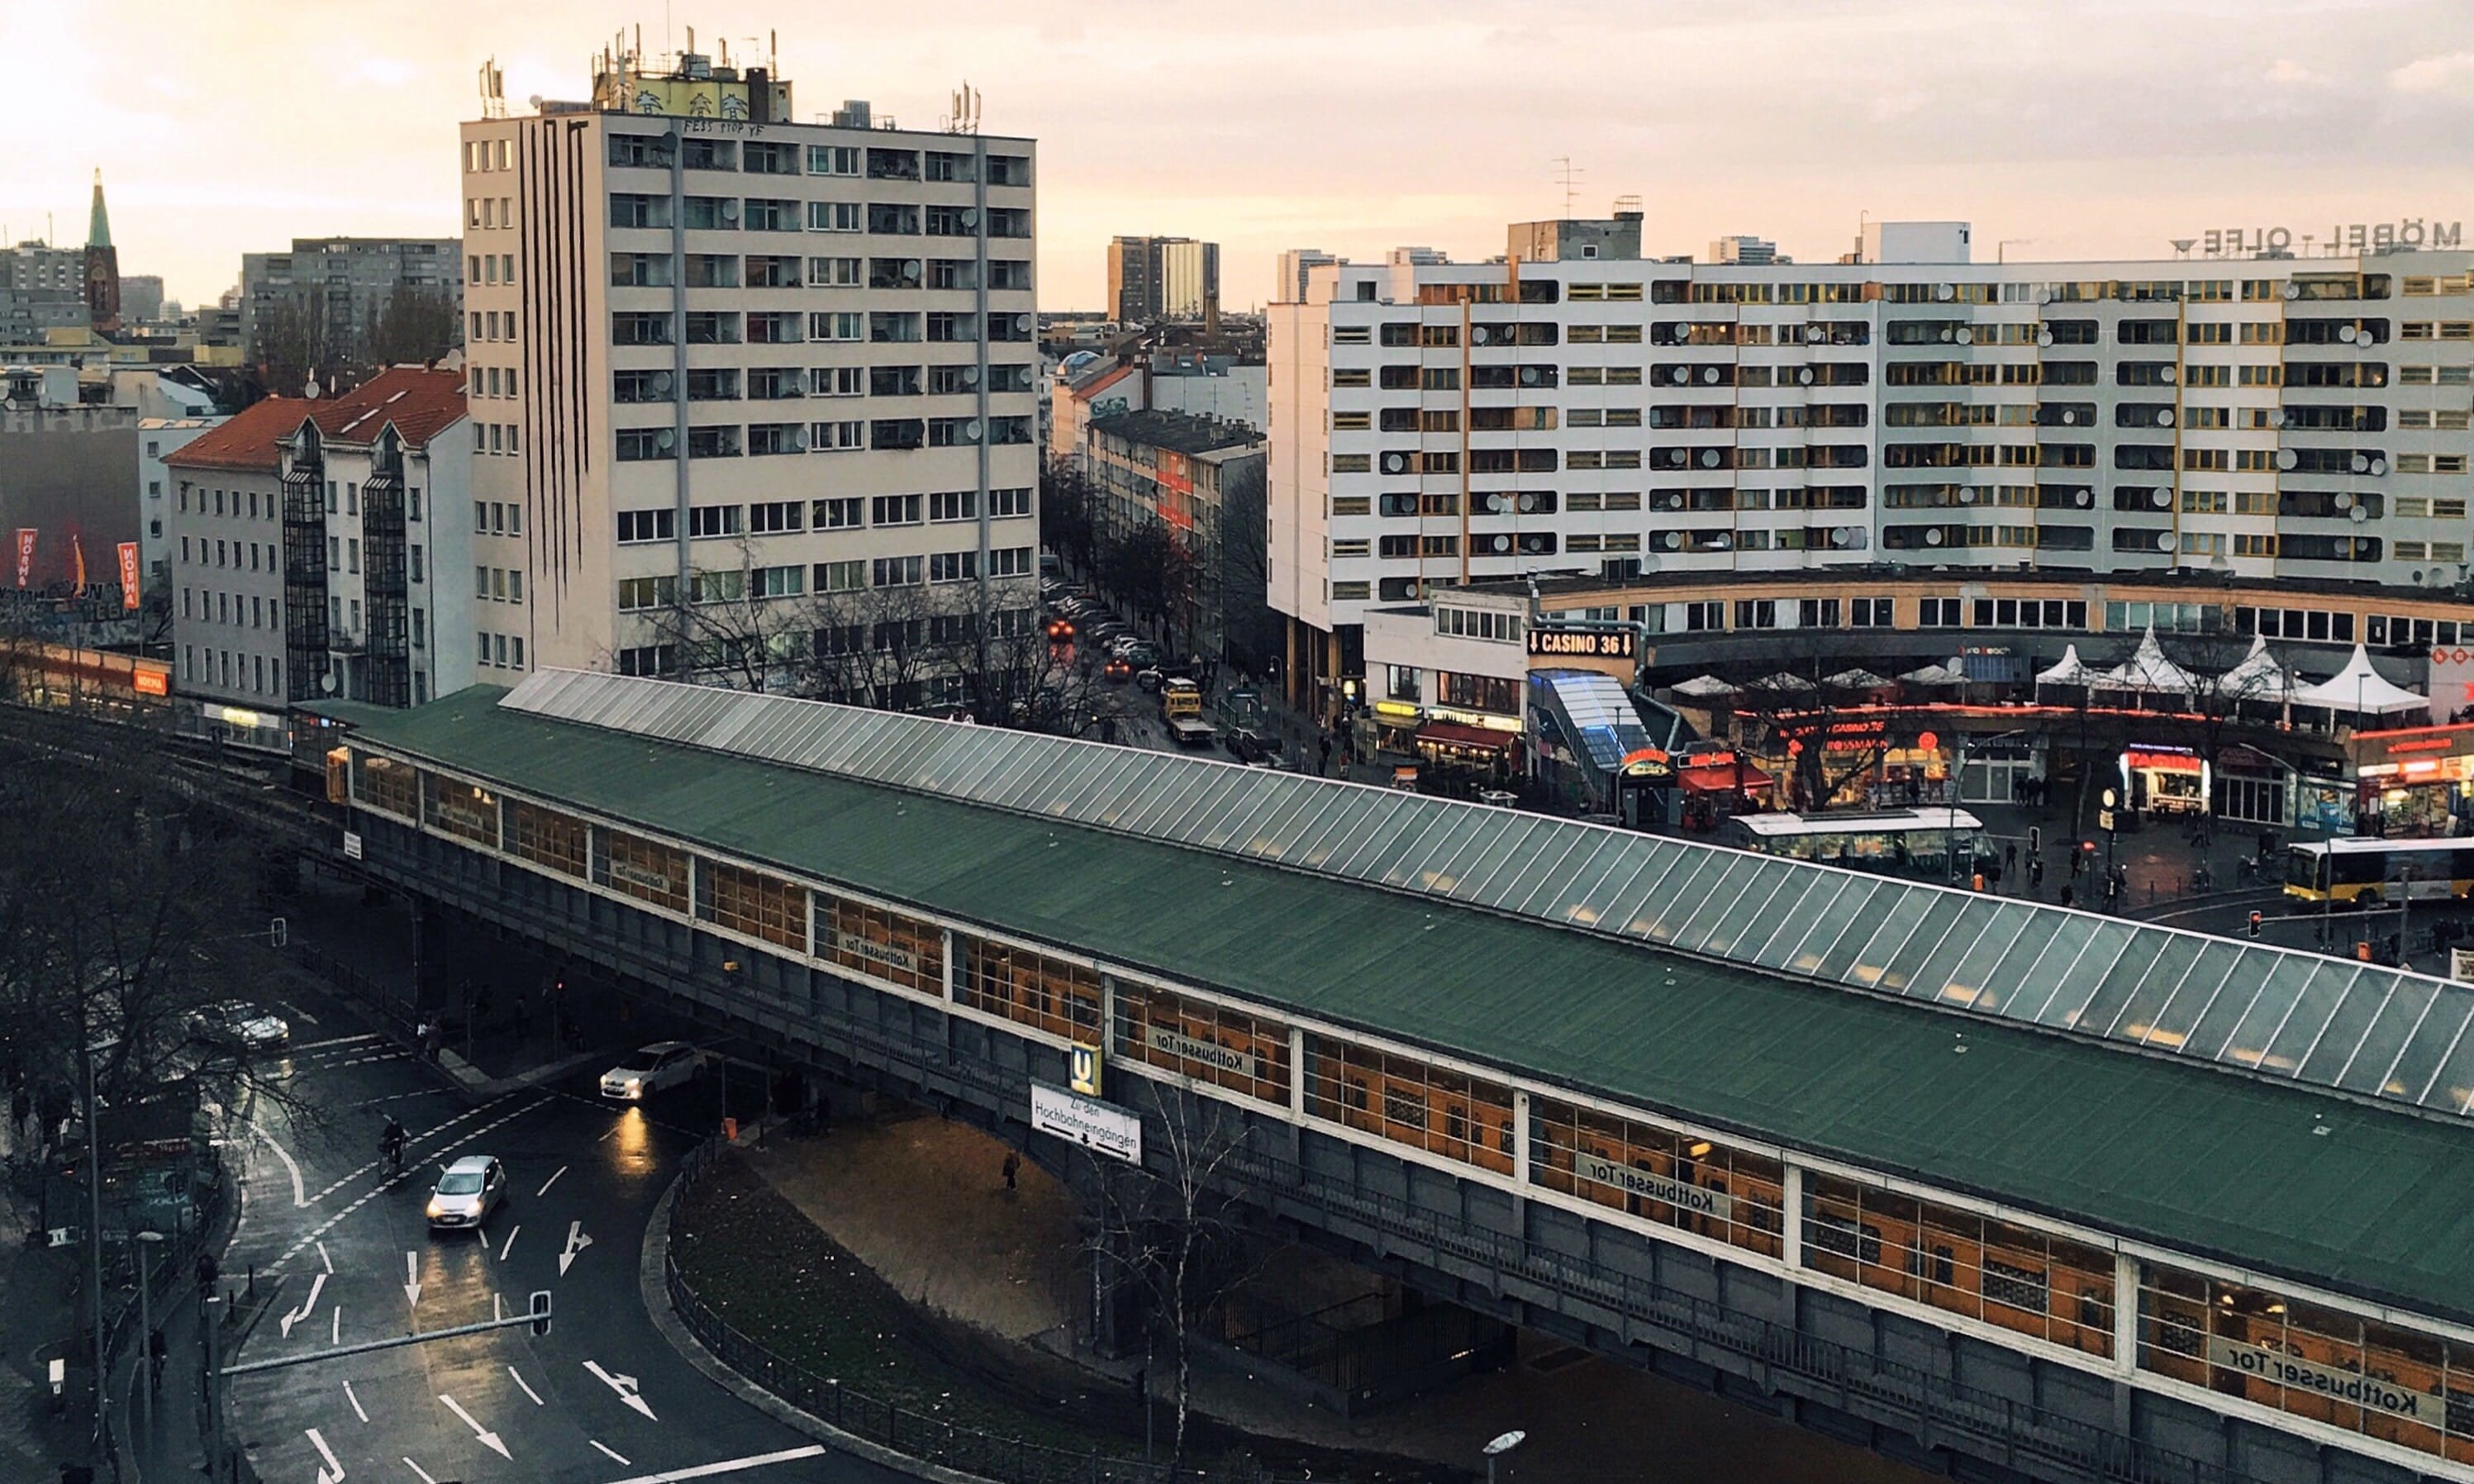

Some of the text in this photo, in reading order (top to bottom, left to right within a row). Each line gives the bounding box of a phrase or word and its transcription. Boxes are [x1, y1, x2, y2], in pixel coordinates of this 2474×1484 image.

[18, 534, 34, 587] NORMA
[1541, 633, 1620, 654] CASINO 36
[1073, 1049, 1092, 1082] U
[1070, 1097, 1101, 1118] Zu den
[1035, 1100, 1138, 1149] Hochbahneingängen
